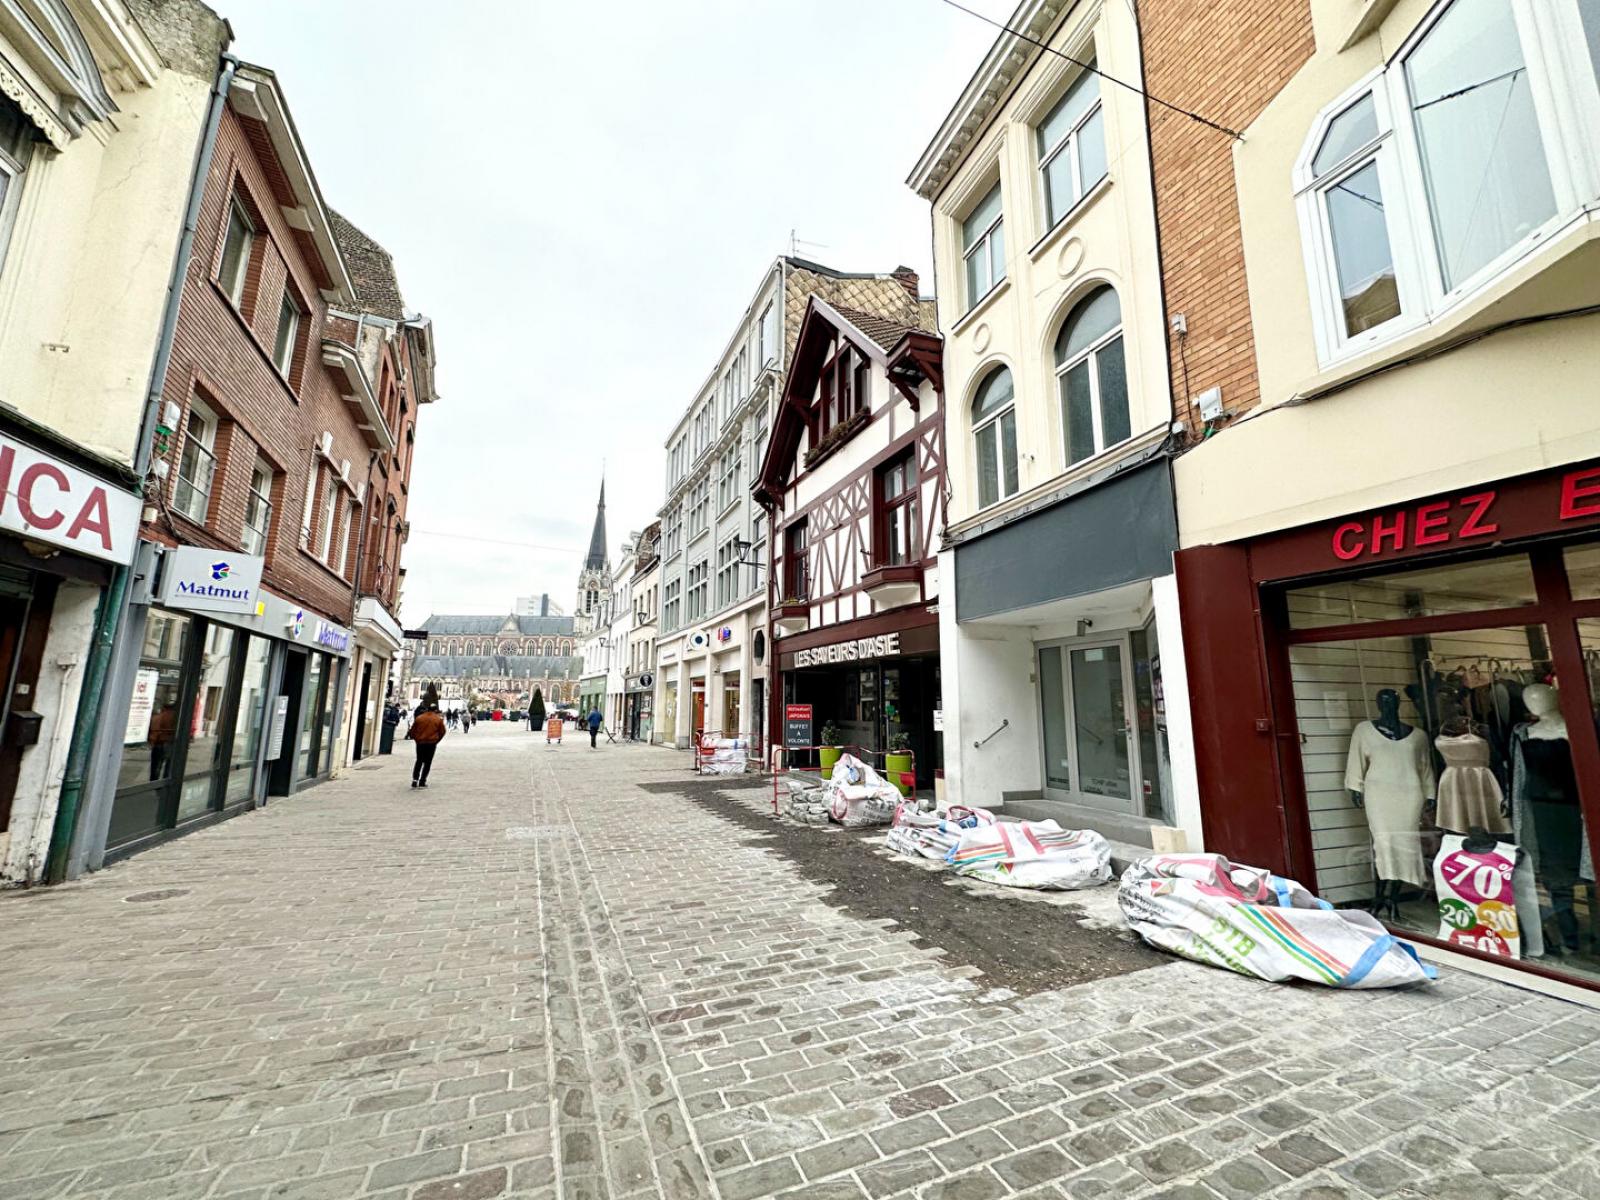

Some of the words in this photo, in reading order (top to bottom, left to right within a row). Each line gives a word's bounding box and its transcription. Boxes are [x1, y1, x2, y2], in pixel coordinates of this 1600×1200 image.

[1332, 491, 1498, 560] CHEZ
[176, 580, 250, 601] Matmut
[793, 649, 811, 668] LES
[810, 640, 859, 666] SAVEURS
[1444, 854, 1514, 900] -70%
